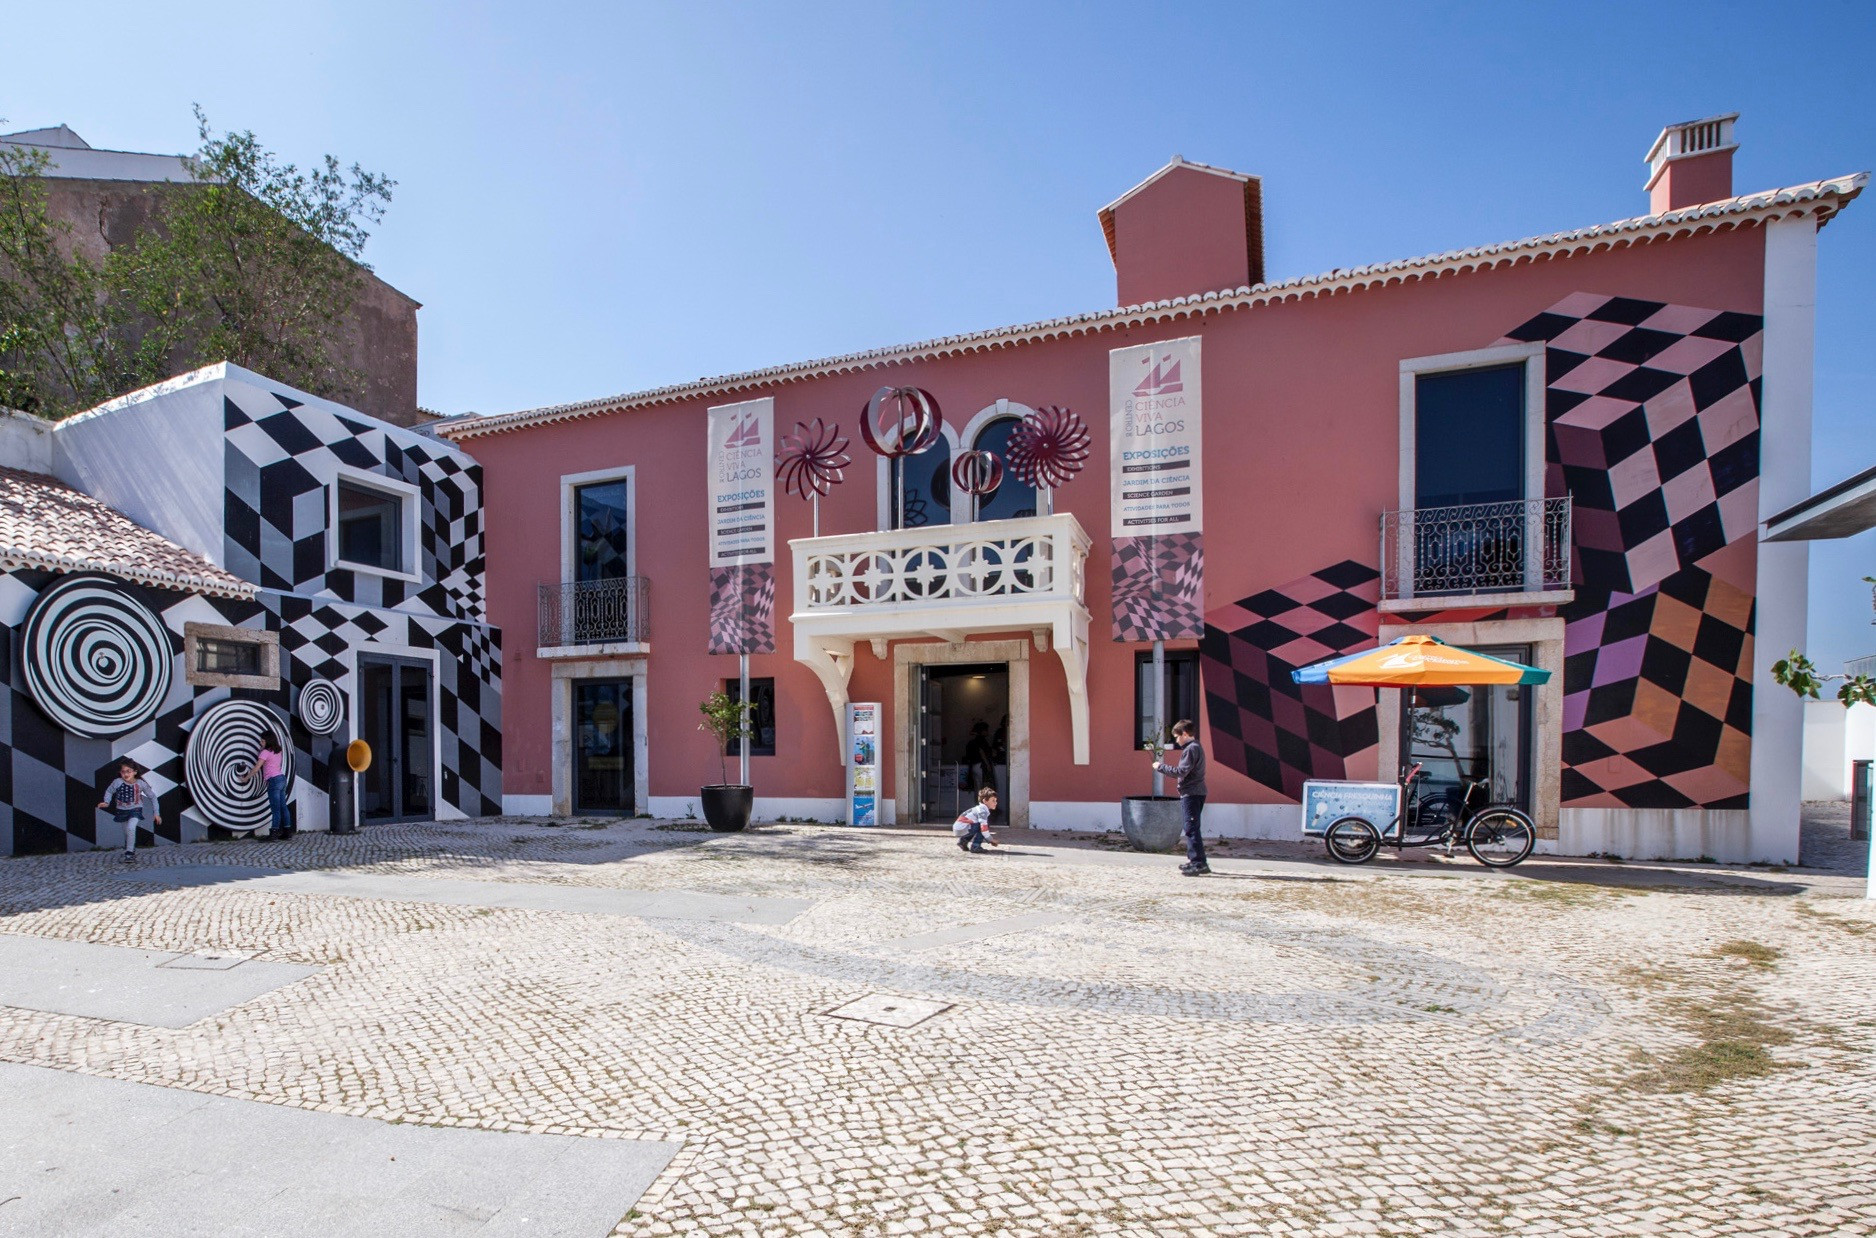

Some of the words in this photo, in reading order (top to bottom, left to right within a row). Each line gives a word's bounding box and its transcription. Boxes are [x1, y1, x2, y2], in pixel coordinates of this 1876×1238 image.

[1135, 396, 1186, 411] CIÊNCIA
[1135, 412, 1163, 423] VIVA
[1135, 420, 1185, 437] LAGOS
[726, 449, 763, 461] CIÊNCIA
[1123, 446, 1190, 460] EXPOSIÇÕES
[727, 461, 746, 470] VIVA
[726, 467, 762, 482] LAGOS
[1123, 479, 1149, 487] JARDIM
[1161, 474, 1190, 484] CIÊNCIA
[717, 490, 765, 502] EXPOSIÇÕES
[1150, 490, 1174, 498] GARDEN
[1312, 789, 1343, 799] CIÊNCIA
